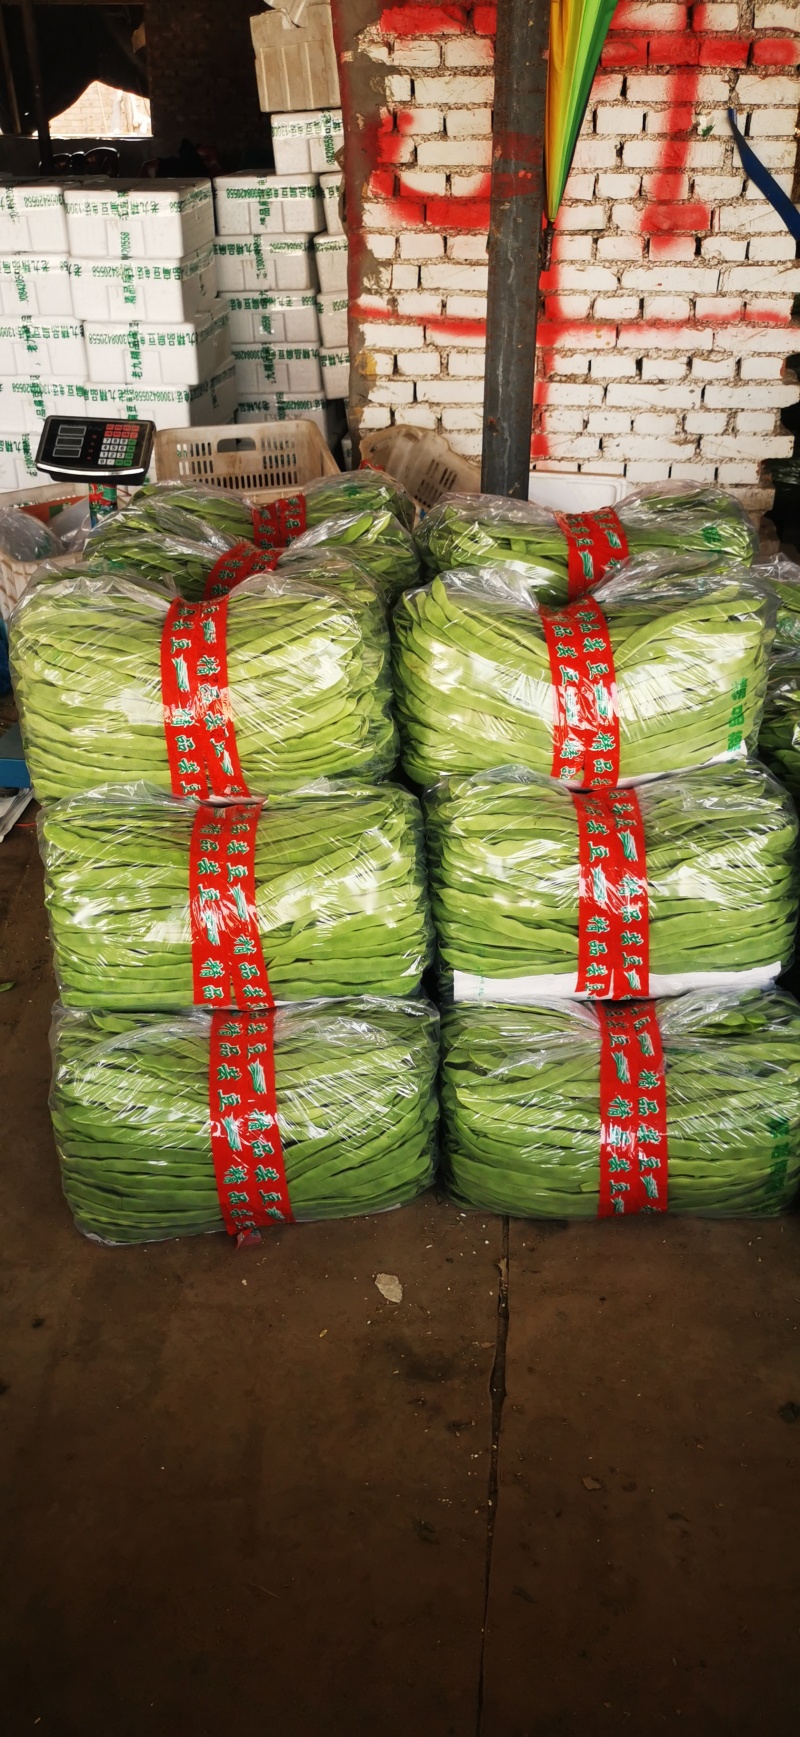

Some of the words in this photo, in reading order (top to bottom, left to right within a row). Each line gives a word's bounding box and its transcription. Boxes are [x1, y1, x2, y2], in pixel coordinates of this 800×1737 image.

[217, 1021, 243, 1113] 精品芸豆
[637, 1069, 662, 1173] 精品芸豆
